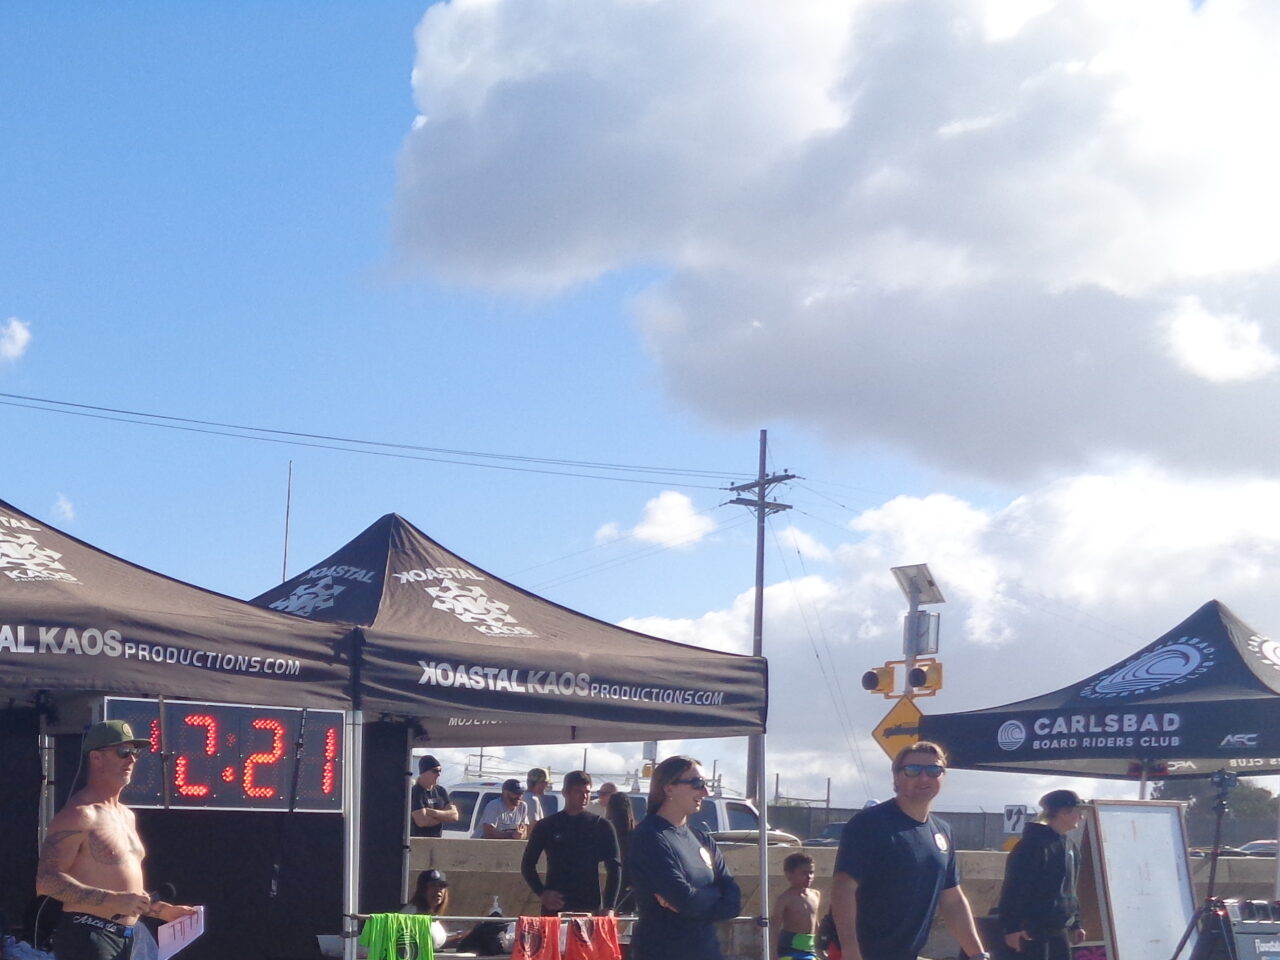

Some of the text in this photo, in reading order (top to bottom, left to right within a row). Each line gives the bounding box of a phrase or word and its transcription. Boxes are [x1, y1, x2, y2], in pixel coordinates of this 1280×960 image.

[3, 569, 78, 581] KAOS
[392, 567, 485, 584] KOASTAL
[472, 625, 534, 636] KAOS
[39, 626, 122, 657] KAOS
[124, 643, 301, 676] PRODUCTIONS.COM
[418, 661, 724, 706] KOASTAL KAOS PRODUCTIONS.COM
[1034, 713, 1180, 735] CARLSBAD
[1033, 736, 1179, 750] BOARD RIDERS CLUB
